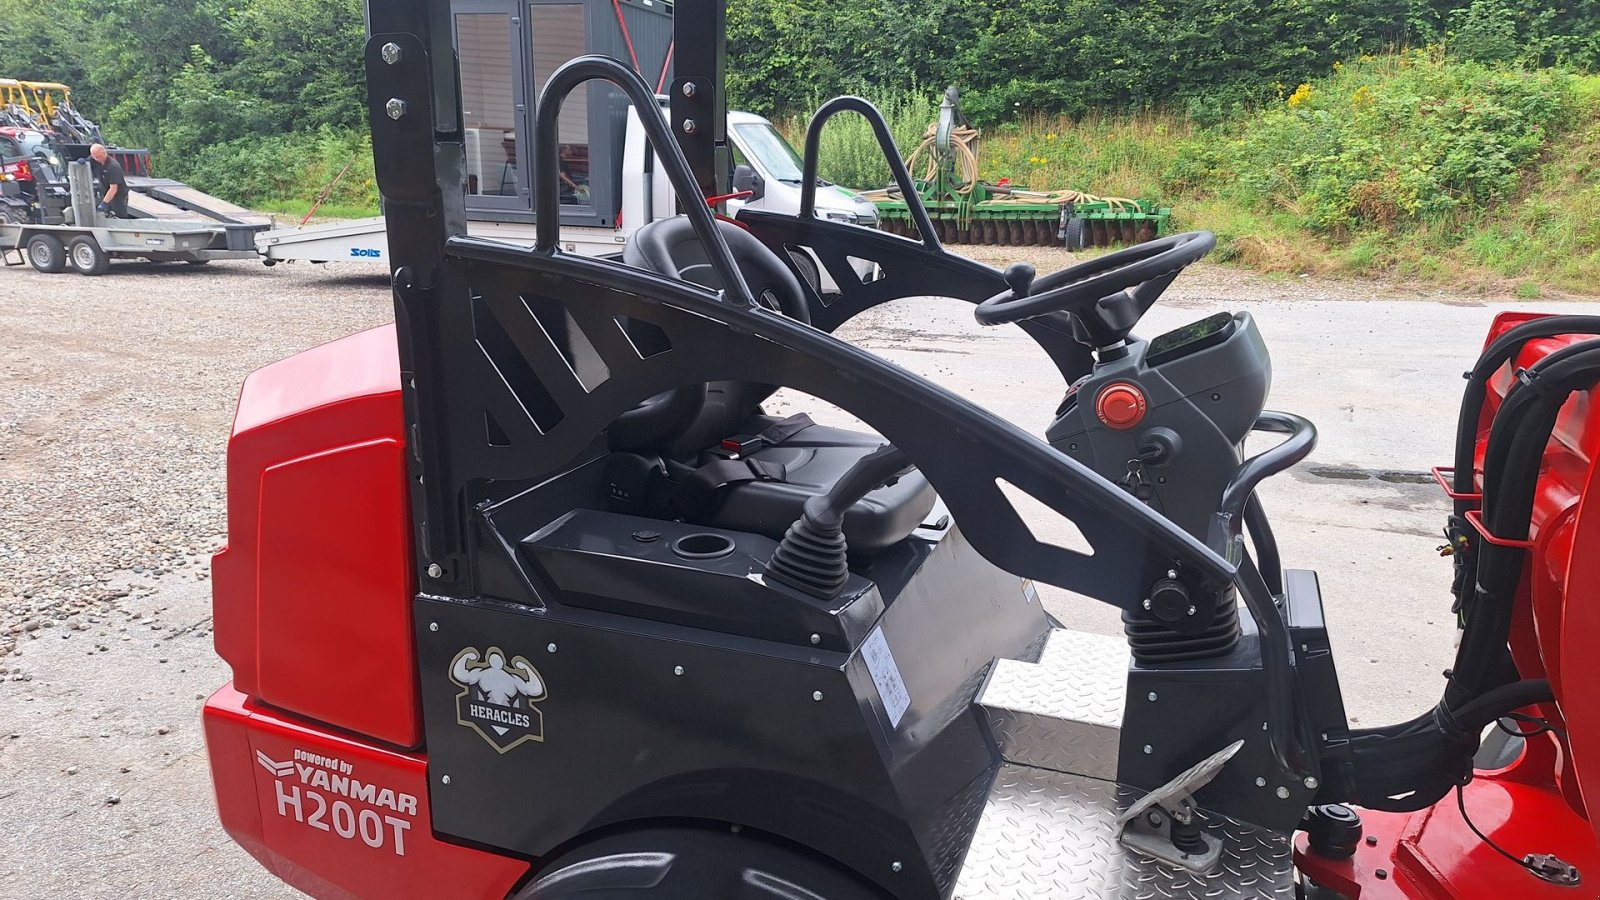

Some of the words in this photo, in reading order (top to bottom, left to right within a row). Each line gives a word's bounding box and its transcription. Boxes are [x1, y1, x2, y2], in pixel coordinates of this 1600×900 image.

[470, 704, 530, 728] HERACLES
[294, 749, 339, 771] powered
[341, 760, 353, 776] by
[295, 762, 418, 816] YANMAR
[275, 779, 411, 856] H200T
